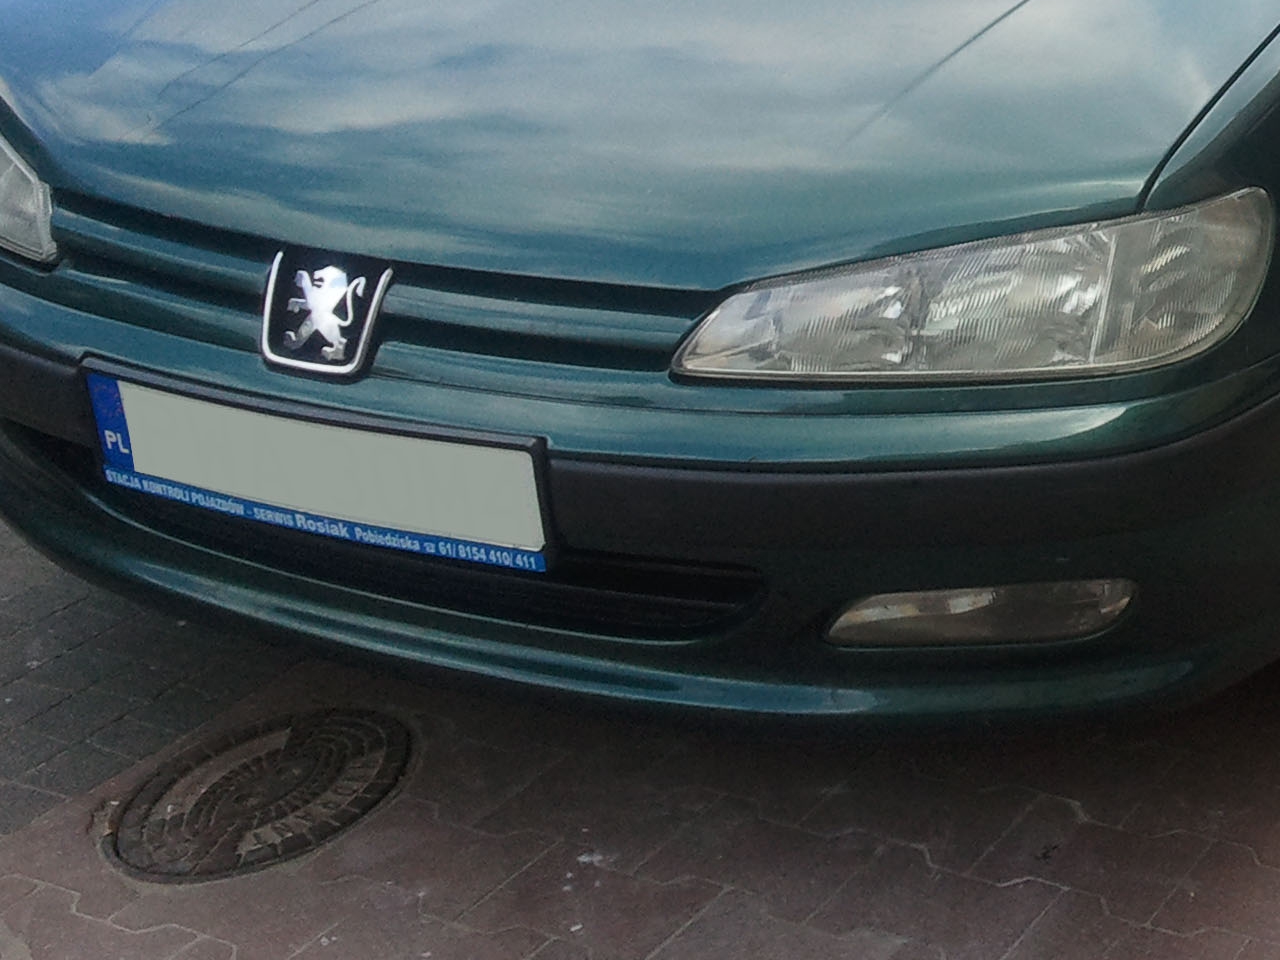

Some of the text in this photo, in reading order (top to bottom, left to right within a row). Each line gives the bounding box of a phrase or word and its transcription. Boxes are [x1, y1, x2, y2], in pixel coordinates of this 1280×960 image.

[104, 430, 130, 453] PL
[105, 469, 142, 489] STACJA
[142, 479, 191, 502] KONTROLI
[191, 491, 244, 515] POJAZDÓW
[254, 508, 294, 527] SERWIS
[295, 513, 349, 538] Rosiak
[354, 526, 420, 551] Pobiedziska
